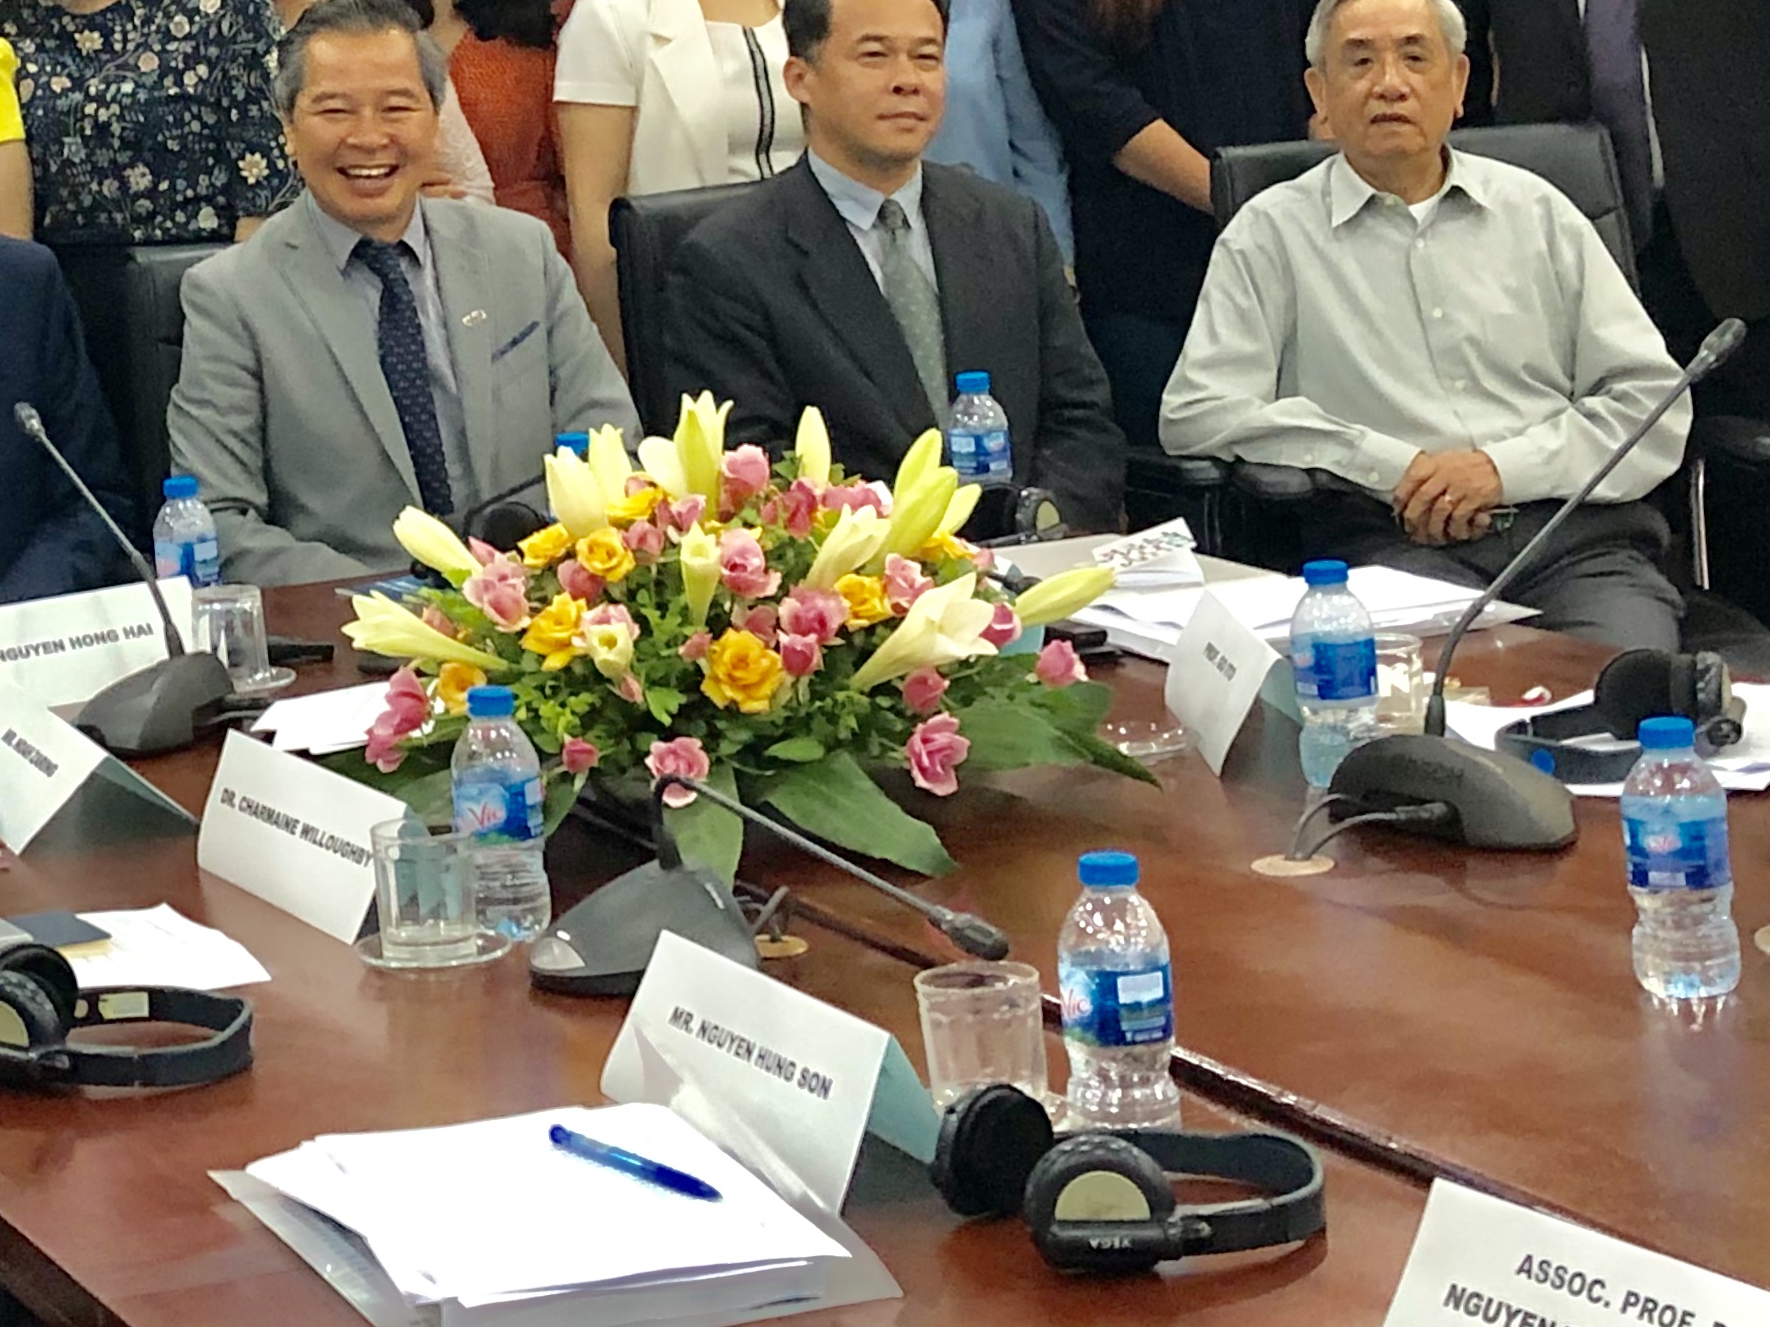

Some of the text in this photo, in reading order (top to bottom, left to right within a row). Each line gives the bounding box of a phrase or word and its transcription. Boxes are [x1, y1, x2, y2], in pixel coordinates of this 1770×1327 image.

[69, 629, 119, 650] HONG
[122, 623, 154, 639] HAI
[238, 796, 300, 835] CHARMAINE
[299, 822, 373, 867] WILLOUGHBY
[669, 1007, 833, 1100] MR. NGUYEN HUNG SON
[1516, 1254, 1610, 1308] ASSOC.
